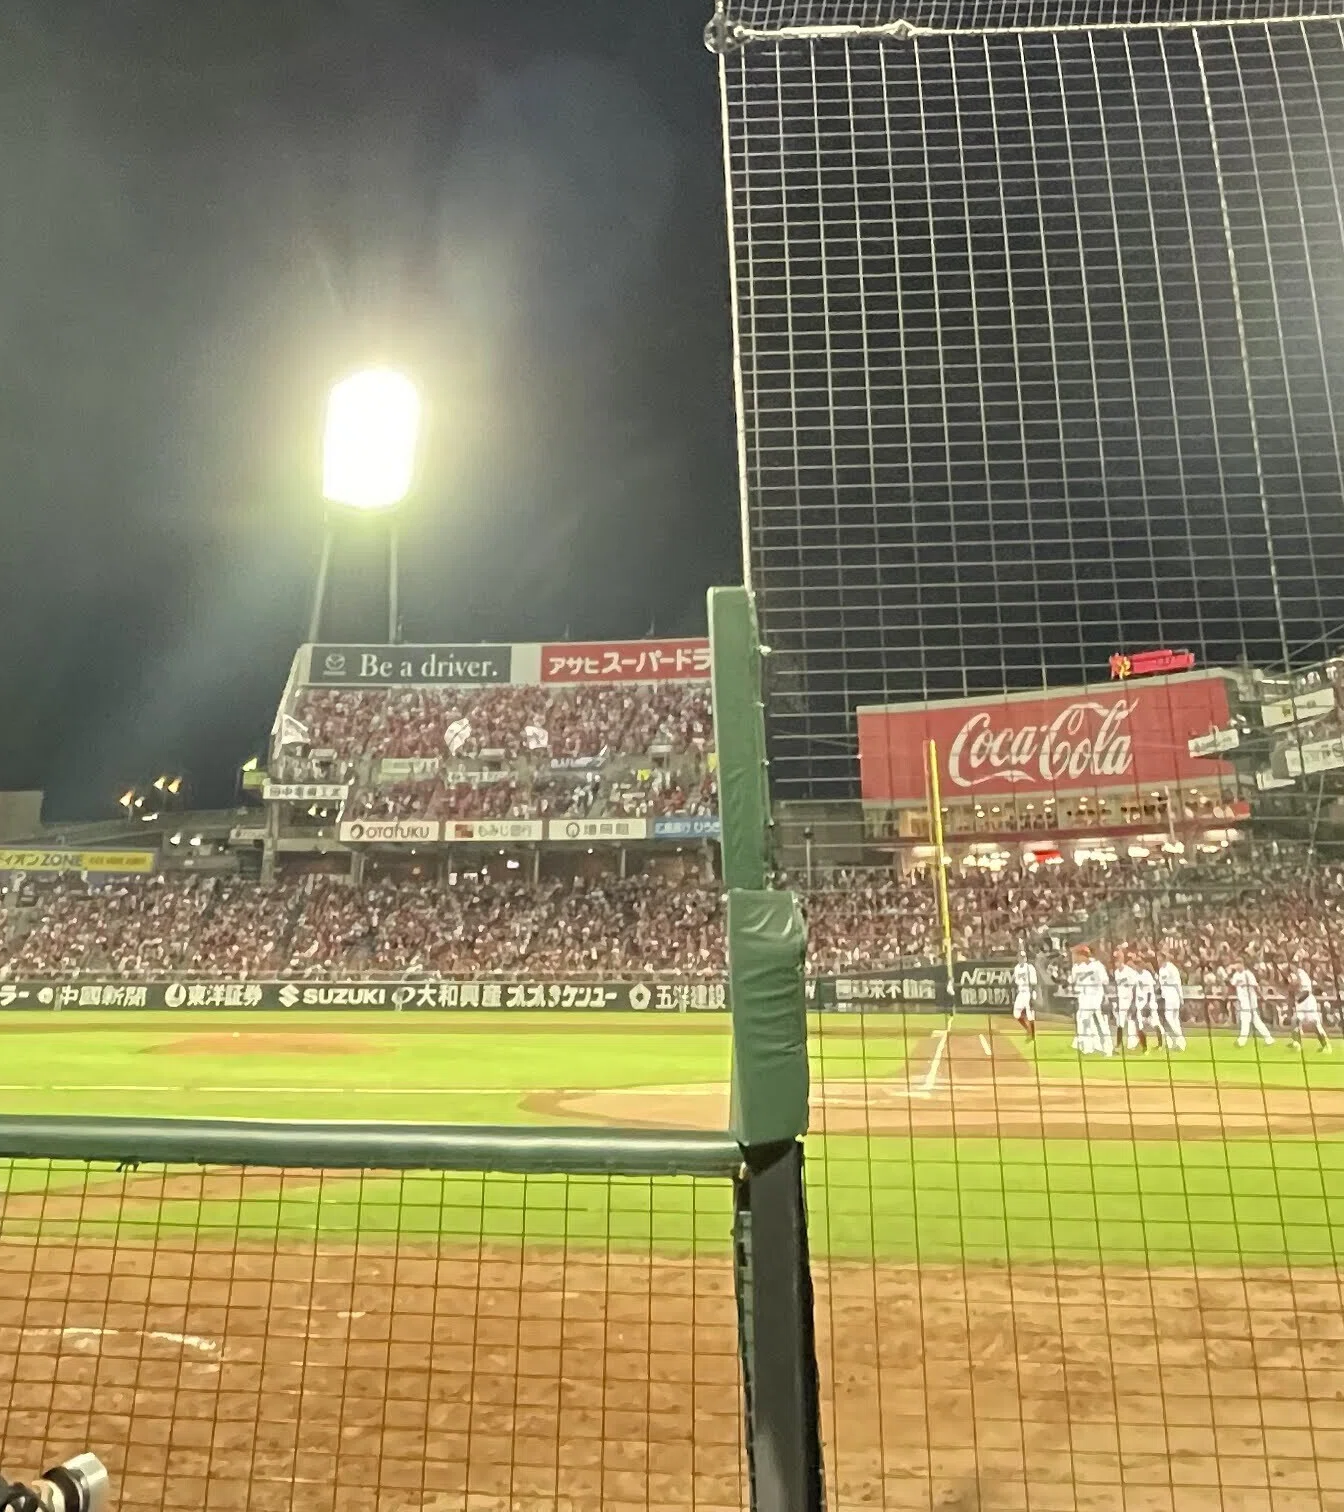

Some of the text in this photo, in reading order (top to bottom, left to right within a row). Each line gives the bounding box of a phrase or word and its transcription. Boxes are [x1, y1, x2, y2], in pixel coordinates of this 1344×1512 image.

[359, 654, 498, 678] Be a driver.
[947, 696, 1140, 787] Coca-Cola
[961, 968, 1016, 985] NOHM
[186, 984, 263, 1007] 東洋証券
[303, 989, 386, 1005] SUZUKI
[416, 984, 502, 1008] 大和興産
[961, 987, 1016, 1005] 能美防
